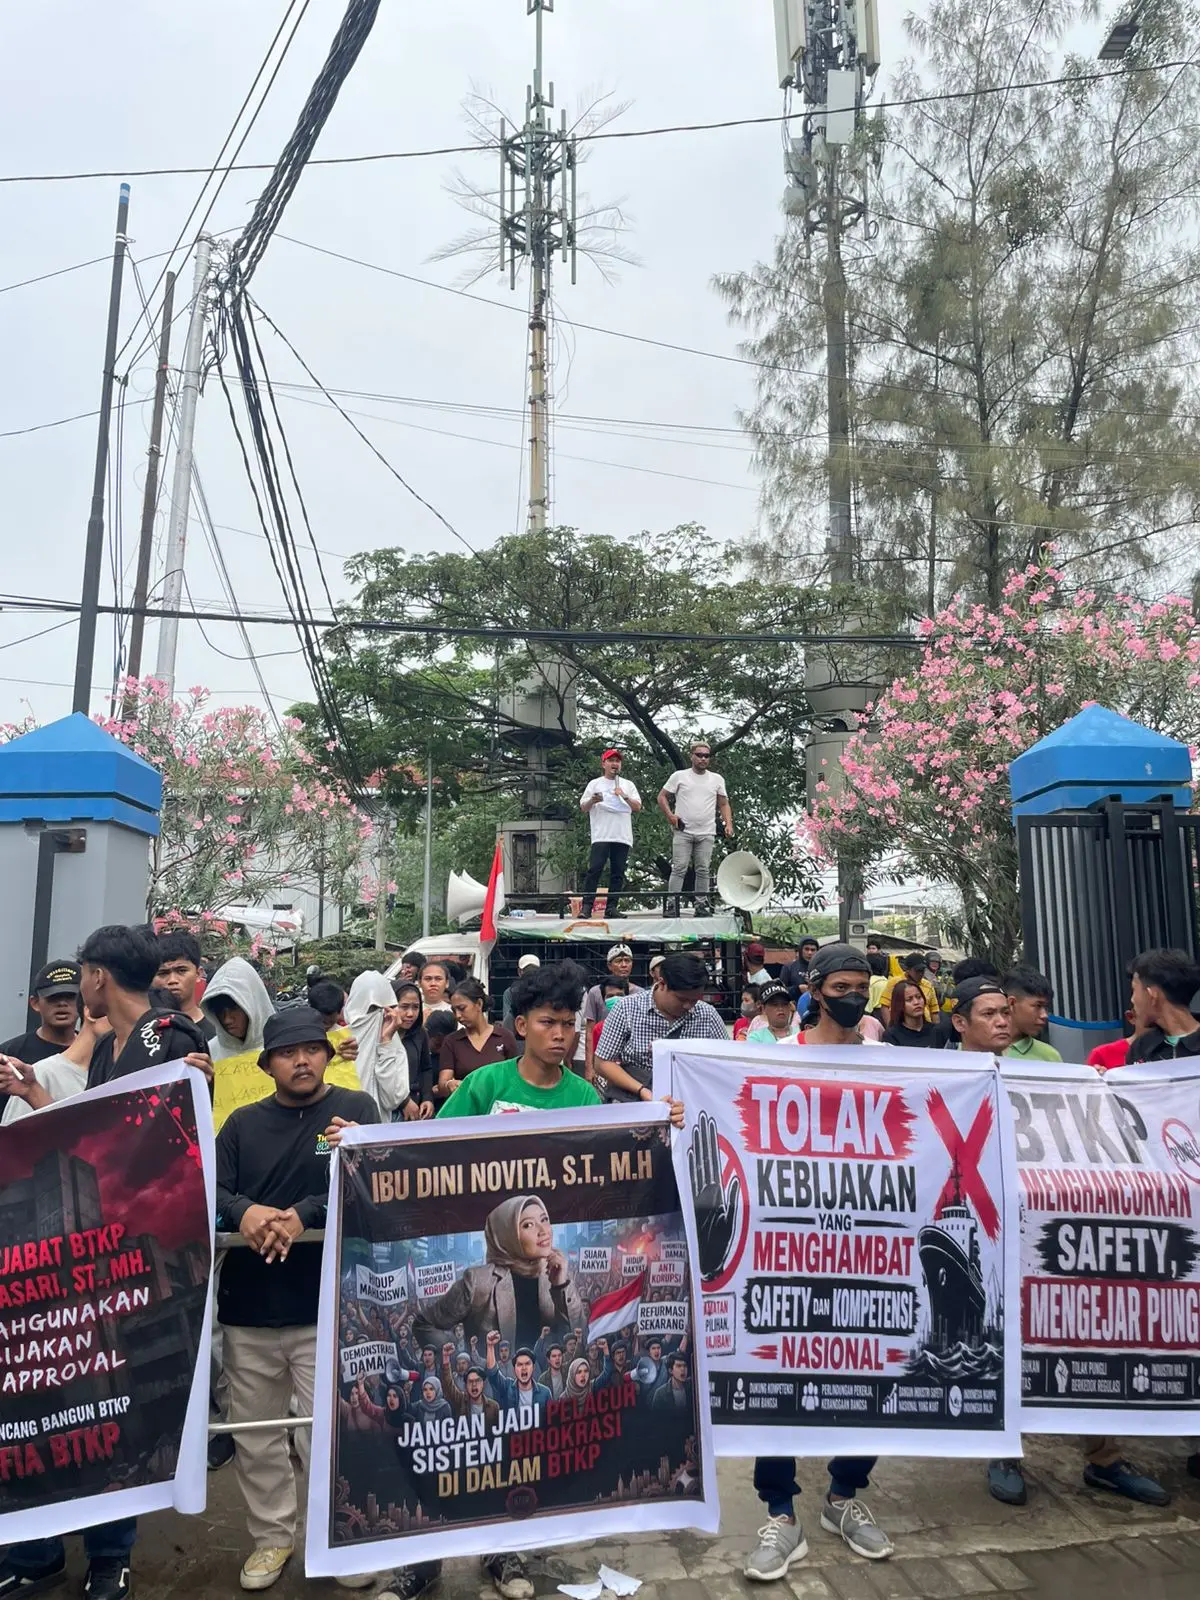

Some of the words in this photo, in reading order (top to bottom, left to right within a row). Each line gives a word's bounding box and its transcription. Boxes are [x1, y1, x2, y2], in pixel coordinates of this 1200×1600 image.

[751, 1083, 895, 1156] TOLAK
[1008, 1091, 1148, 1163] BTKP
[371, 1168, 410, 1204] IBU
[416, 1165, 463, 1199] DINI
[471, 1158, 557, 1192] NOVITA,
[562, 1154, 605, 1187] S.T.,
[610, 1150, 653, 1181] M.H
[757, 1158, 917, 1213] KEBIJAKAN
[1019, 1168, 1192, 1218] MENGHANCURKAN
[818, 1213, 852, 1231] YANG
[70, 1223, 126, 1260] BTKP
[584, 1250, 607, 1259] SUARA
[753, 1231, 915, 1276] MENGHAMBAT
[1057, 1224, 1177, 1278] SAFETY,
[368, 1272, 395, 1288] HIDUP
[418, 1265, 452, 1276] TURUNKAN
[418, 1274, 453, 1287] BIROKRASI
[581, 1260, 608, 1270] RAKYAT
[651, 1274, 681, 1283] KORUPSI
[658, 1264, 675, 1273] ANTI
[360, 1284, 406, 1302] MAHASISWA
[423, 1284, 449, 1296] KORUP
[750, 1285, 812, 1327] SAFETY
[813, 1298, 830, 1316] DAN
[832, 1288, 914, 1330] KOMPETENSI
[639, 1318, 685, 1331] SEKARANG
[1030, 1283, 1141, 1342] MENGEJAR
[0, 1331, 92, 1366] IJAKAN
[781, 1336, 884, 1371] NASIONAL
[2, 1349, 127, 1393] APPROVAL
[1071, 1361, 1088, 1374] TOLAK
[42, 1403, 95, 1431] BANGUN
[99, 1396, 131, 1418] BTKP
[398, 1412, 485, 1447] JANGAN
[493, 1403, 540, 1436] JADI
[546, 1383, 636, 1425] PELACUR
[49, 1422, 121, 1468] BTKP
[412, 1437, 502, 1474] SISTEM
[510, 1412, 622, 1457] BIROKRASI
[438, 1472, 459, 1497] DI
[466, 1456, 541, 1493] DALAM
[548, 1443, 600, 1478] BTKP
